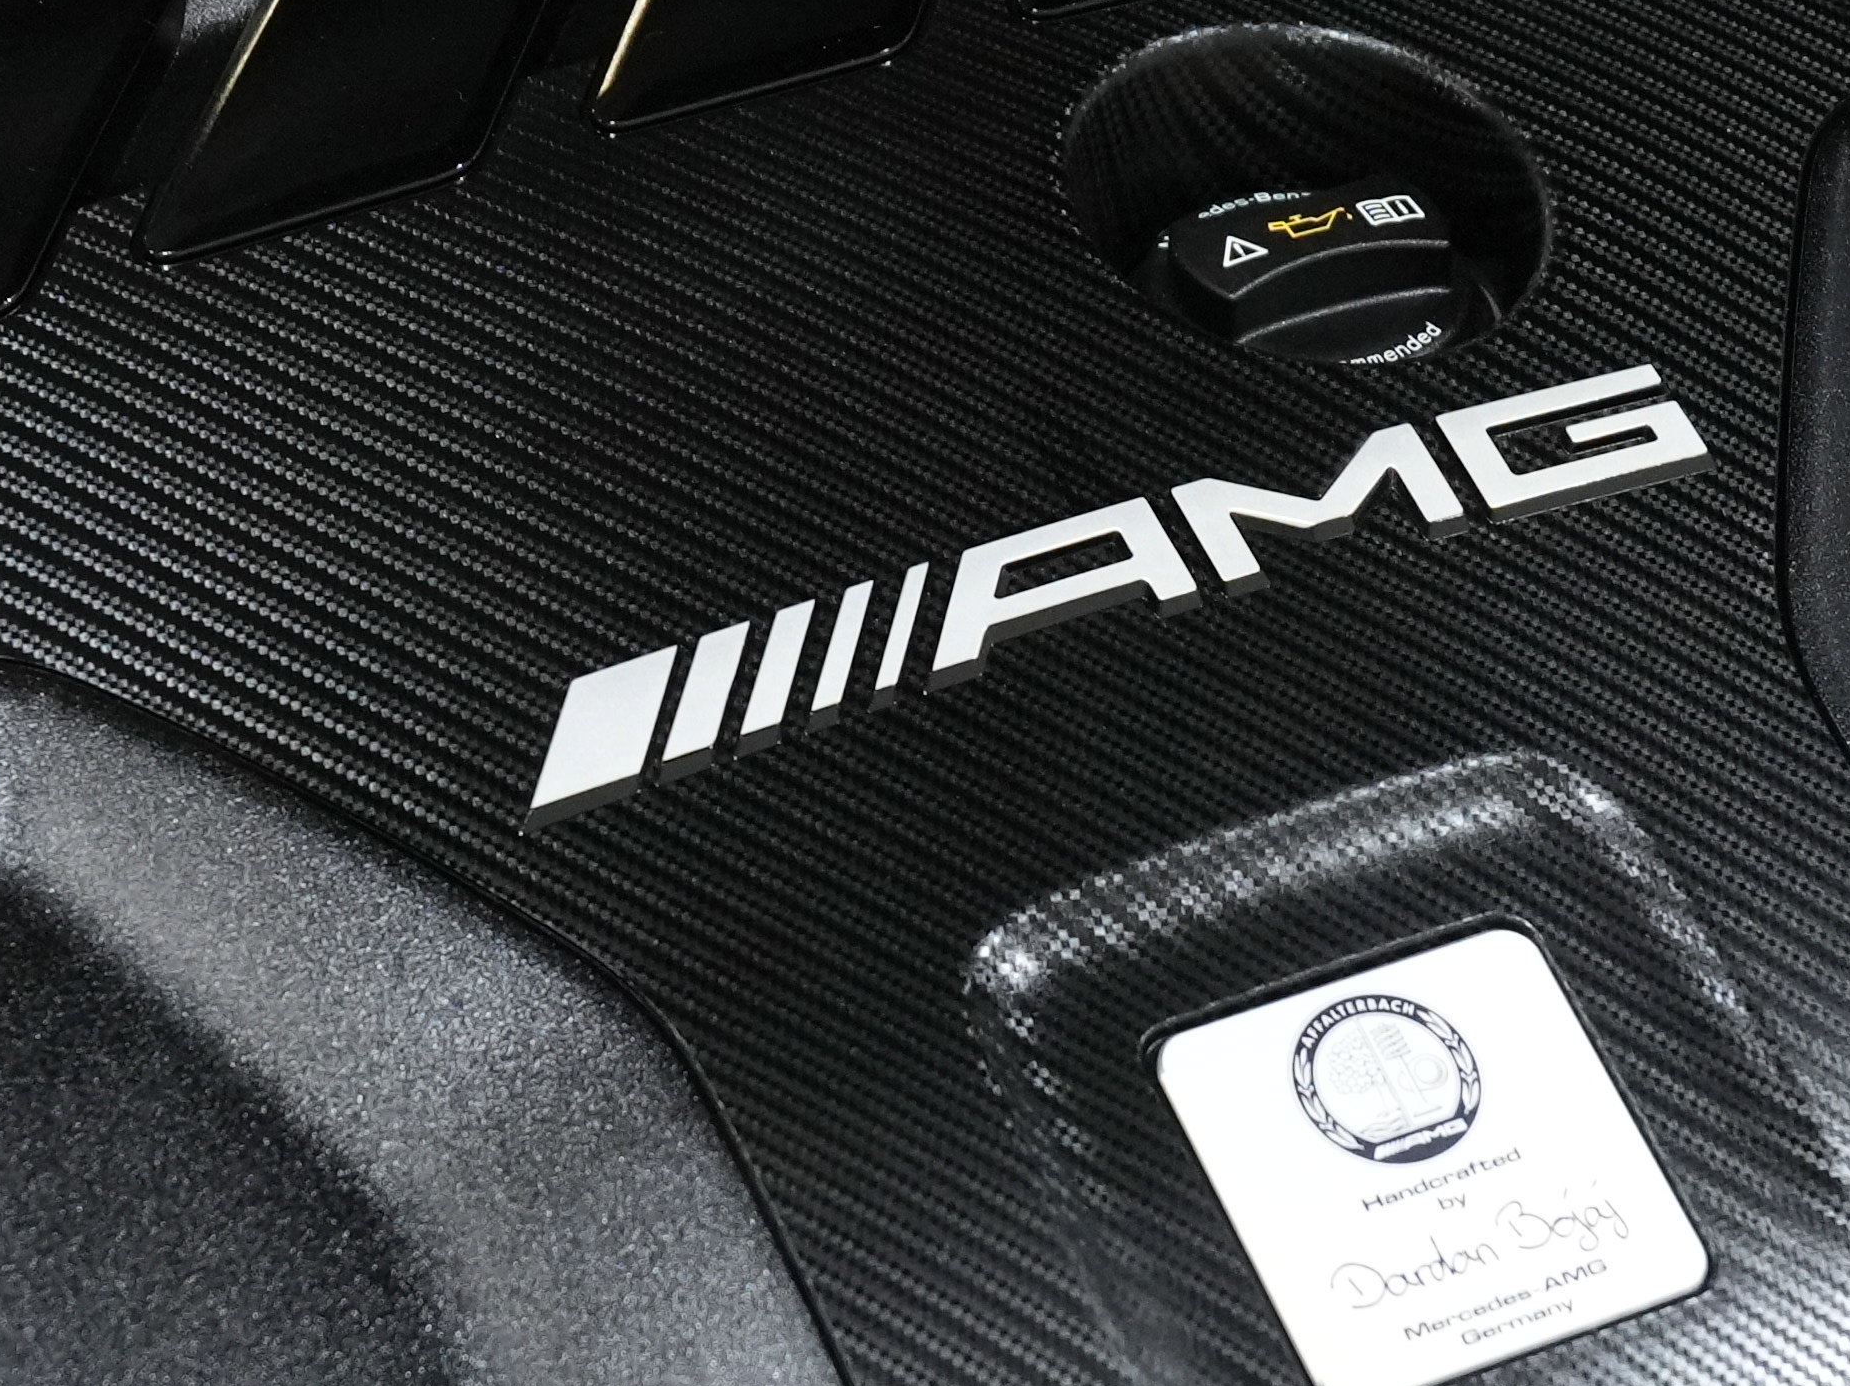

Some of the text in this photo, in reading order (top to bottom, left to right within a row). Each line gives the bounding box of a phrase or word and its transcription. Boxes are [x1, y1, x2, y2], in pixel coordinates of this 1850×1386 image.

[1197, 191, 1312, 219] edes-Ben
[1338, 320, 1443, 365] mmended
[1300, 997, 1416, 1049] AFFALTERBACH
[1362, 1147, 1522, 1212] Handcrafted
[1437, 1193, 1467, 1211] by
[1403, 1259, 1608, 1341] Mercedes-AMG
[1460, 1299, 1574, 1346] Germany
